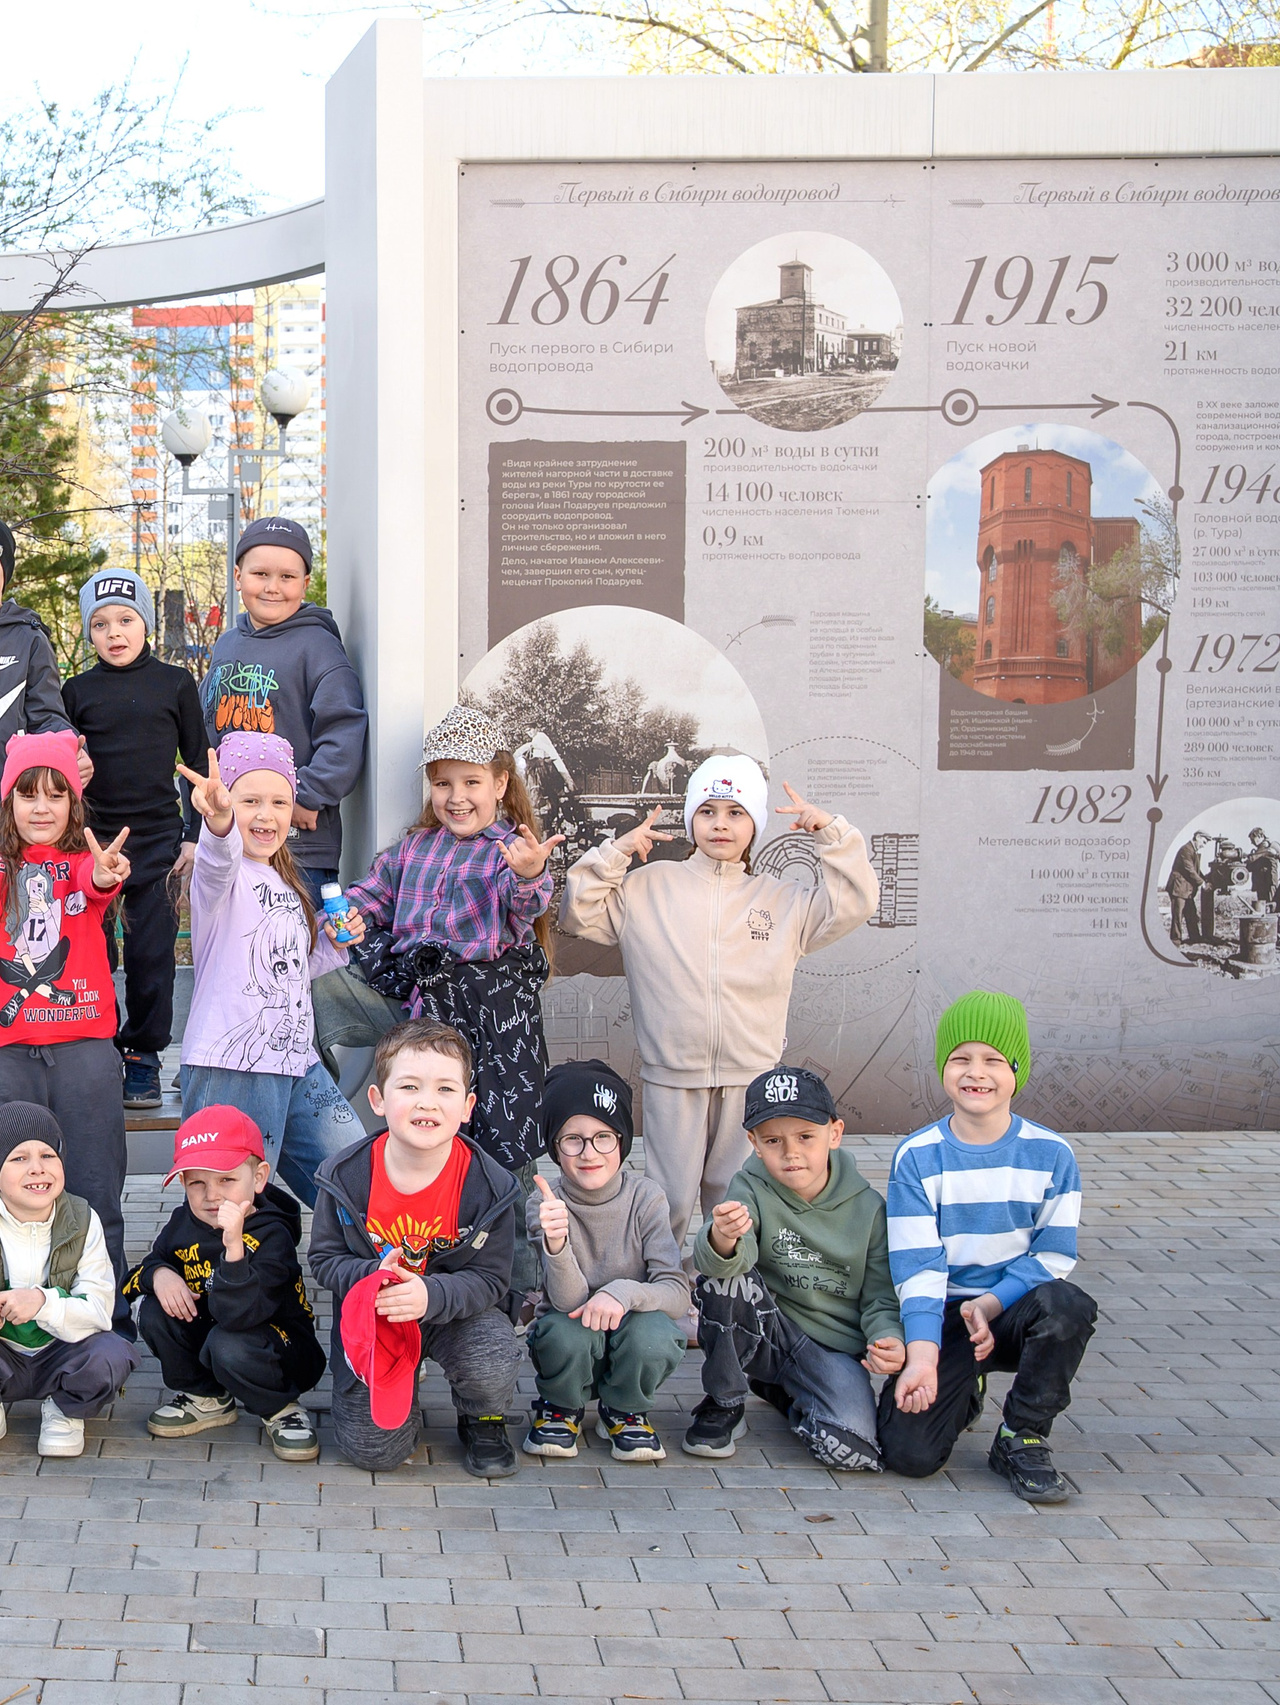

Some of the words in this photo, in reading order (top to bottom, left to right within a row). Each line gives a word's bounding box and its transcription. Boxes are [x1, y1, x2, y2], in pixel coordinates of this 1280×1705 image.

[554, 181, 634, 207] Первый
[639, 190, 649, 202] в
[655, 181, 727, 206] Сибири
[732, 182, 841, 206] водопровод
[1013, 181, 1093, 207] Первый
[1100, 190, 1110, 202] в
[1115, 181, 1189, 206] Сибири
[1167, 252, 1178, 272] 3
[1186, 252, 1229, 272] 000
[487, 253, 677, 325] 1864
[940, 253, 1120, 327] 1915
[1166, 297, 1193, 316] 32
[1200, 296, 1242, 316] 200
[490, 342, 526, 357] Пуск
[532, 344, 595, 356] первого
[600, 344, 608, 353] в
[612, 341, 673, 354] Сибири
[947, 341, 984, 355] Пуск
[989, 340, 1036, 352] новой
[1164, 341, 1186, 360] 21
[1197, 350, 1216, 360] км
[490, 362, 593, 375] водопровода
[946, 361, 1029, 372] водокачки
[1164, 368, 1248, 377] протяженность
[704, 438, 746, 458] 200
[775, 447, 814, 460] воды
[821, 447, 829, 457] в
[834, 446, 878, 462] сутки
[502, 459, 531, 468] «Видя
[534, 459, 574, 468] крайнее
[576, 460, 637, 468] затруднение
[703, 464, 817, 472] производительность
[820, 464, 877, 472] водокачки
[502, 470, 543, 478] жителей
[546, 469, 591, 479] нагорной
[630, 470, 673, 478] доставке
[568, 480, 592, 490] Туры
[609, 481, 650, 489] крутости
[502, 490, 542, 500] берега»,
[572, 492, 594, 500] году
[596, 490, 646, 500] городской
[707, 482, 729, 501] 14
[737, 482, 773, 501] 100
[779, 491, 842, 501] человек
[564, 501, 610, 510] Подаруев
[612, 502, 666, 510] предложил
[836, 507, 879, 516] Тюмени
[502, 513, 551, 521] соорудить
[554, 513, 614, 521] водопровод.
[1194, 513, 1252, 523] Головной
[502, 534, 573, 542] строительство,
[703, 526, 736, 548] 0,9
[744, 536, 763, 546] км
[1194, 527, 1207, 539] (р.
[1210, 527, 1242, 540] Тура)
[540, 543, 602, 552] сбережения.
[501, 557, 528, 566] Дело,
[702, 553, 786, 562] протяженность
[789, 552, 861, 561] водопровода
[615, 568, 646, 576] купец-
[97, 579, 134, 596] UFC
[545, 578, 593, 587] Прокопий
[596, 578, 644, 587] Подаруев.
[1182, 633, 1280, 673] 1972
[1186, 684, 1271, 694] Велижанский
[1185, 699, 1275, 710] (артезианские
[1184, 742, 1205, 753] 289
[1208, 742, 1230, 753] 000
[1232, 744, 1273, 753] человек
[1183, 768, 1204, 778] 336
[1207, 770, 1221, 778] км
[1025, 785, 1132, 824] 1982
[979, 836, 1060, 846] Метелевский
[1065, 836, 1131, 848] водозабор
[1082, 850, 1095, 862] (р.
[1098, 850, 1130, 862] Тура)
[27, 918, 47, 941] 17
[72, 978, 87, 990] YOU
[78, 990, 100, 1003] LOOK
[23, 1006, 101, 1022] WONDERFUL
[765, 1074, 798, 1088] OUT
[764, 1087, 799, 1103] SIDE
[181, 1131, 219, 1150] SANY
[784, 1274, 810, 1290] NYC
